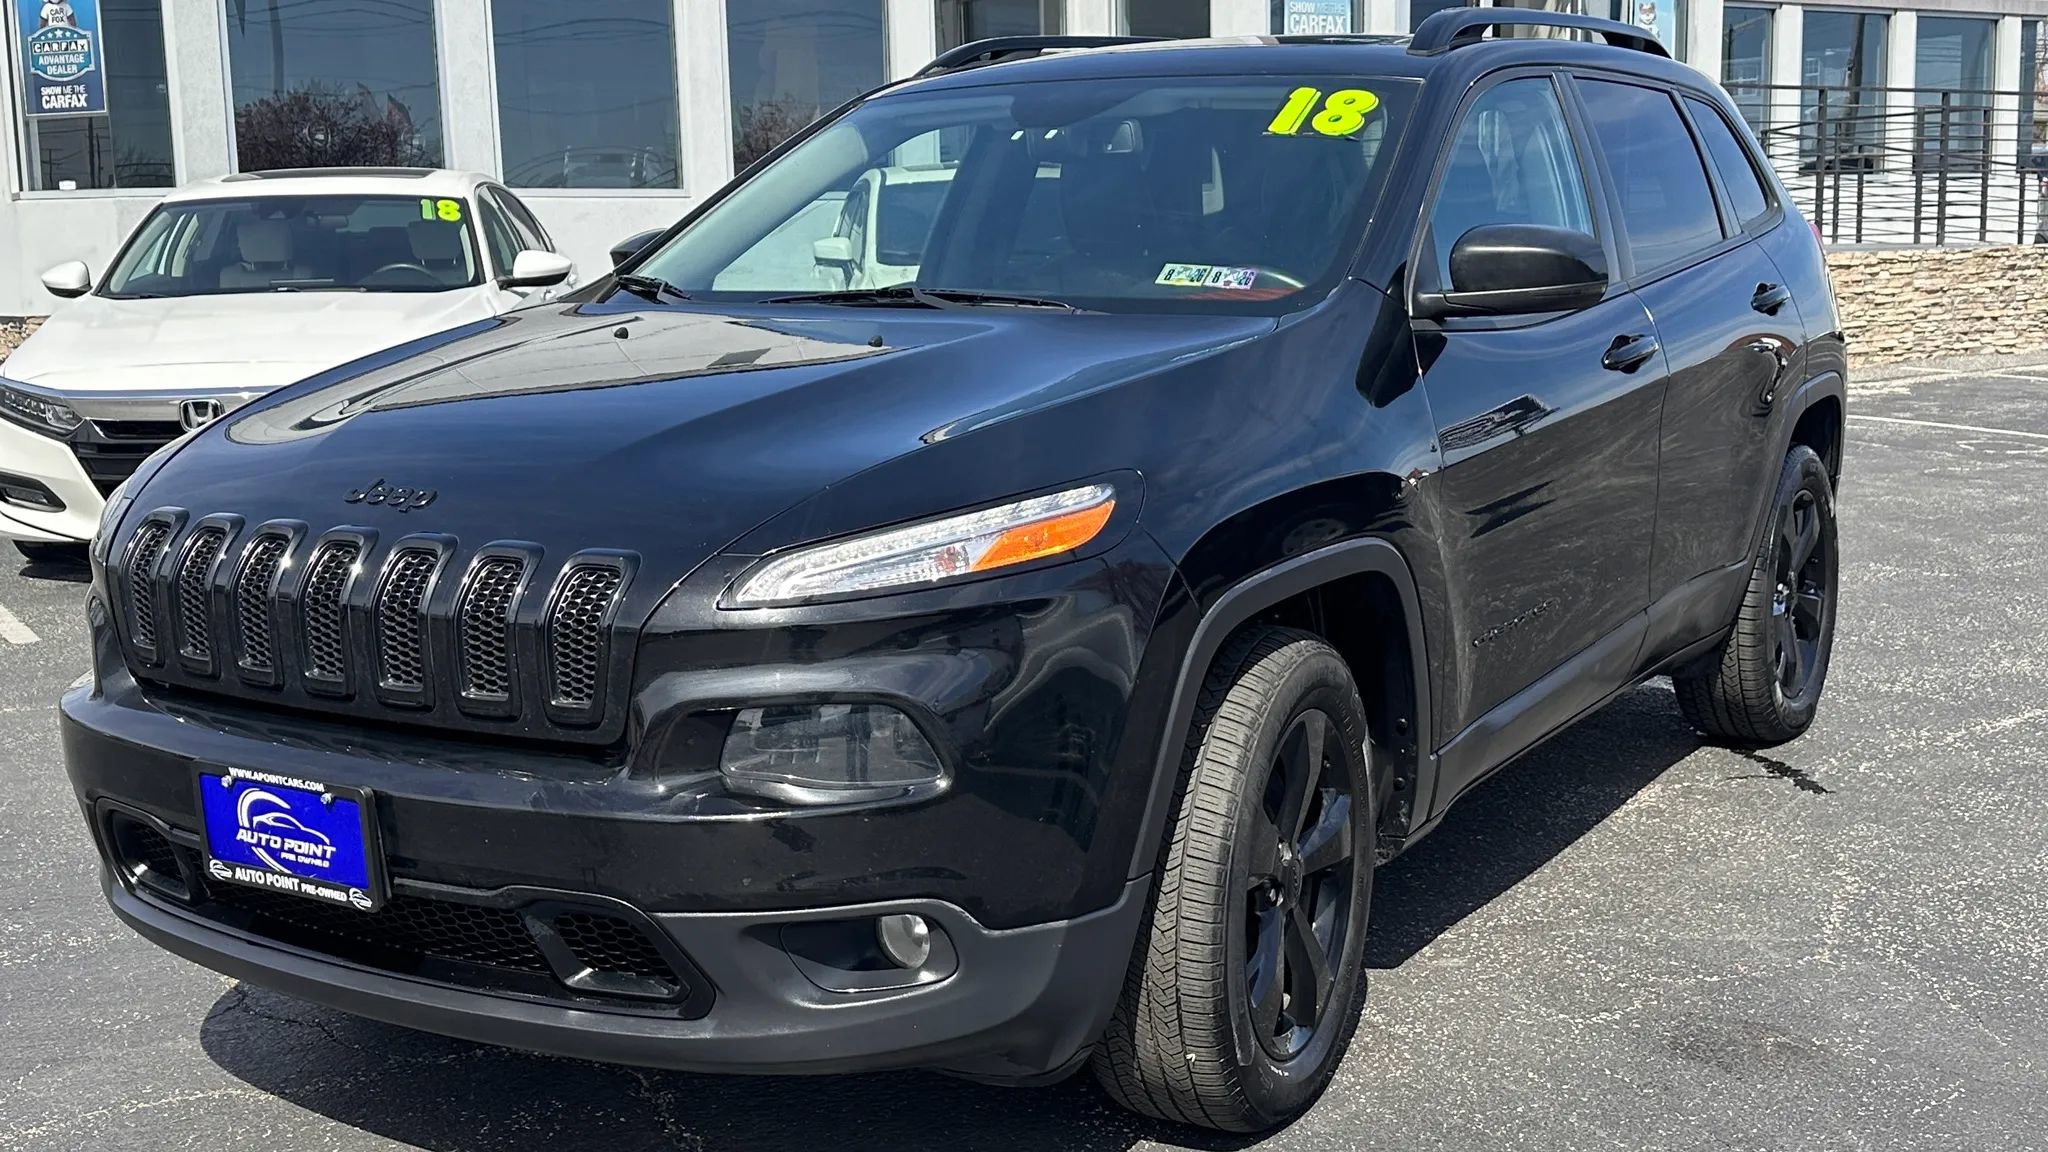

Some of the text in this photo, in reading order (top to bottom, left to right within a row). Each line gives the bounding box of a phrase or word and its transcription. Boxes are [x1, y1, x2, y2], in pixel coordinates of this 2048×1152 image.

[1290, 2, 1315, 13] SHOW
[1290, 14, 1346, 34] CARFAX
[33, 40, 87, 53] CARFAX
[38, 54, 85, 65] ADVANTAGE
[47, 65, 77, 75] DEALER
[41, 84, 86, 95] SHOW ME THE
[42, 94, 87, 109] CARFAX
[1268, 87, 1379, 136] 18
[421, 198, 462, 222] 18
[1164, 268, 1175, 282] 8
[1212, 271, 1222, 284] 8
[343, 479, 438, 513] Jeep
[228, 767, 325, 792] WWW.APOINTCARS.COM
[236, 828, 337, 860] AUTO POINT
[234, 867, 265, 884] AUTO
[265, 872, 300, 892] POINT
[301, 883, 347, 902] PRE-OWNED
